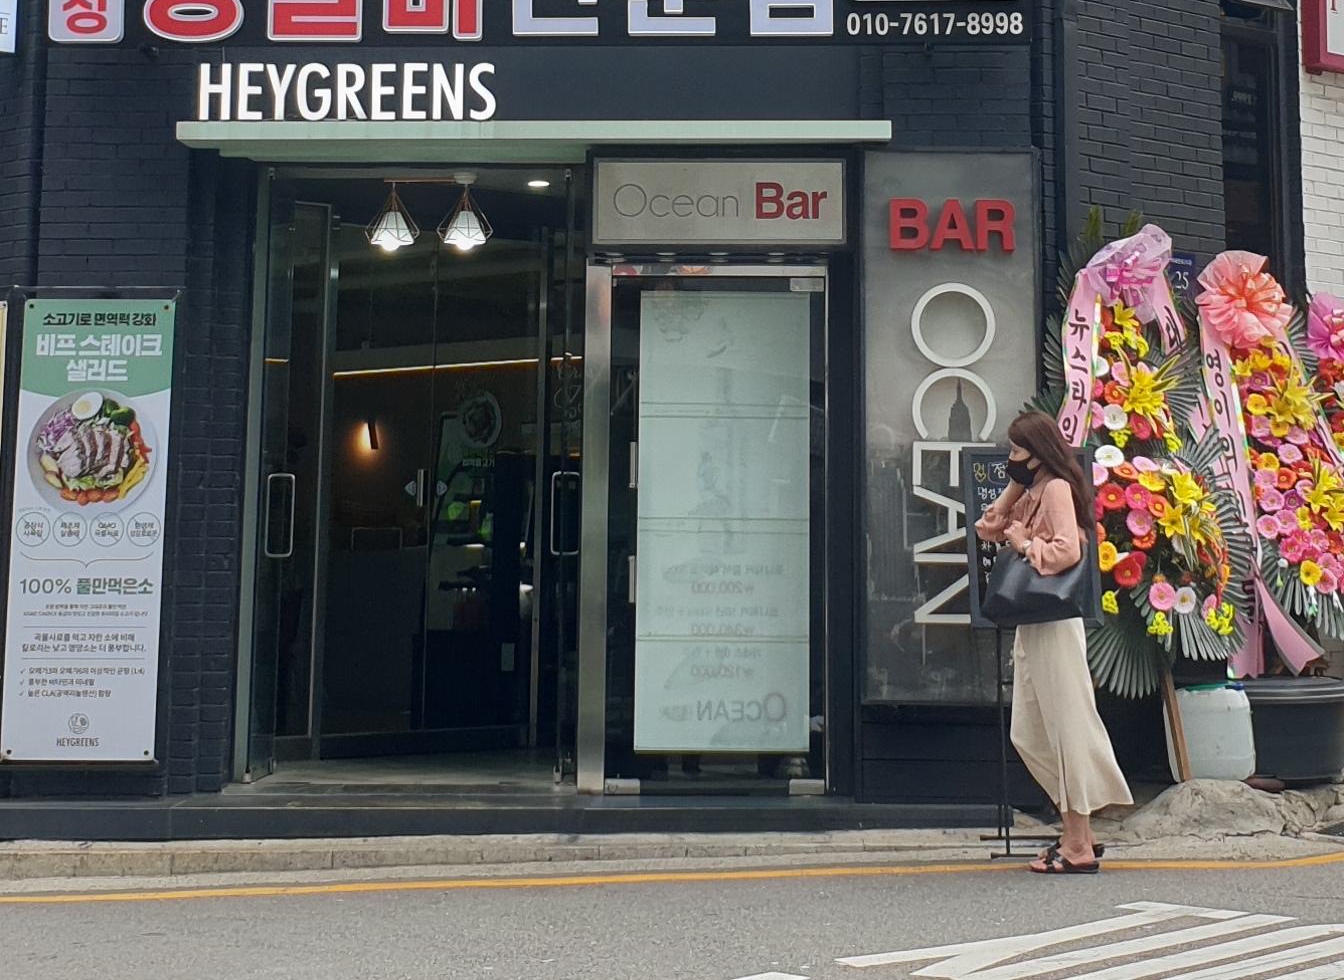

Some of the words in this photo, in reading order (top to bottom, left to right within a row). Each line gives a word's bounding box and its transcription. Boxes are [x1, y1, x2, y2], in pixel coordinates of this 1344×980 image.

[846, 12, 1024, 37] 010-7617-8998
[199, 62, 497, 121] HEYGREENS
[613, 183, 740, 219] Ocean
[755, 182, 828, 221] Bar
[889, 197, 1017, 253] BAR
[1175, 271, 1189, 290] 25
[42, 313, 92, 327] 소고기로
[94, 312, 130, 327] 면역력
[131, 312, 156, 327] 강화
[35, 333, 76, 357] 비프
[79, 333, 163, 357] 스테이크
[66, 359, 129, 382] 샐러드
[910, 283, 996, 624] OCEAN
[19, 578, 72, 594] 100%
[77, 577, 154, 595] 풀만먹은소
[56, 737, 99, 747] HEYGREENS
